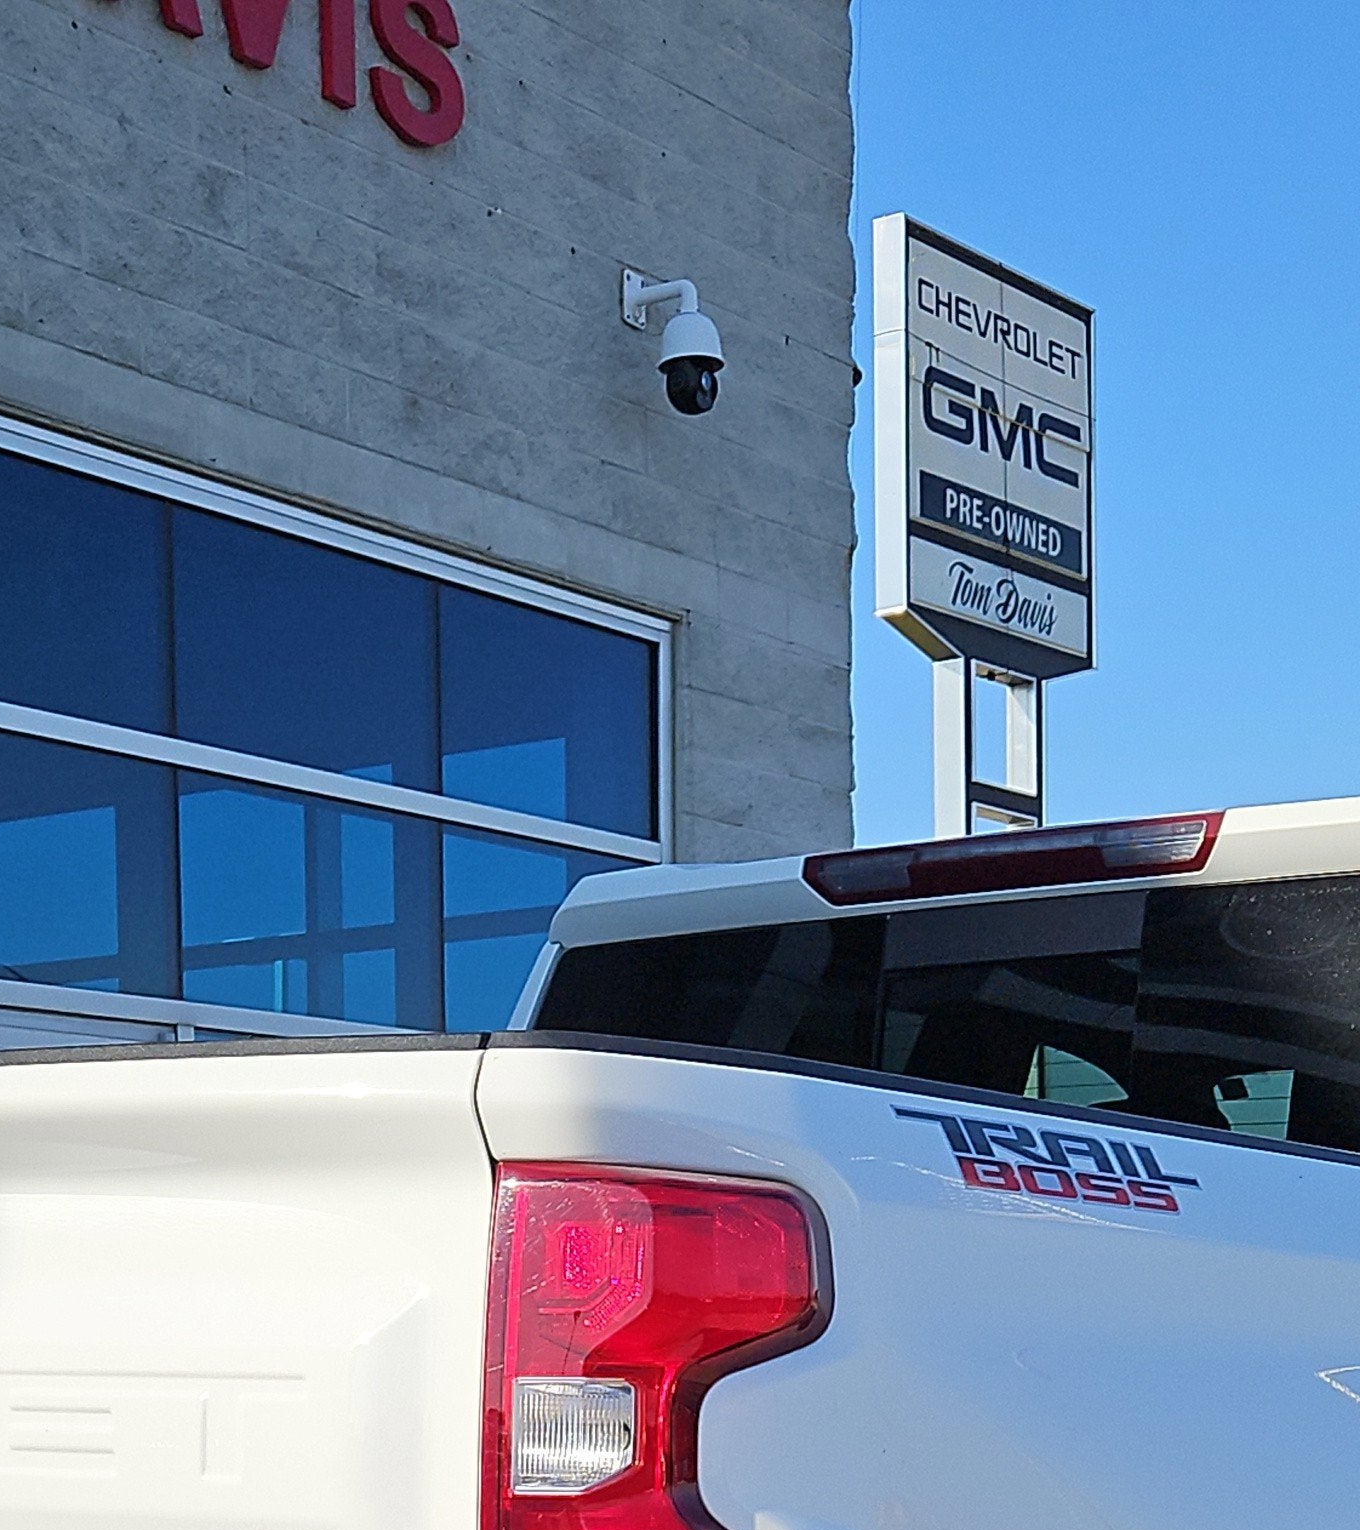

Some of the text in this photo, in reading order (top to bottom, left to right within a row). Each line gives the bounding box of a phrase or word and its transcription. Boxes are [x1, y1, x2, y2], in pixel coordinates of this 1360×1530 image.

[917, 276, 1082, 380] CHEVROLET
[922, 365, 1082, 489] GMC
[944, 487, 1063, 557] PRE-OWNED
[948, 561, 1058, 636] Tom Davis
[890, 1104, 1202, 1189] TRAIL
[955, 1155, 1180, 1214] BOSS
